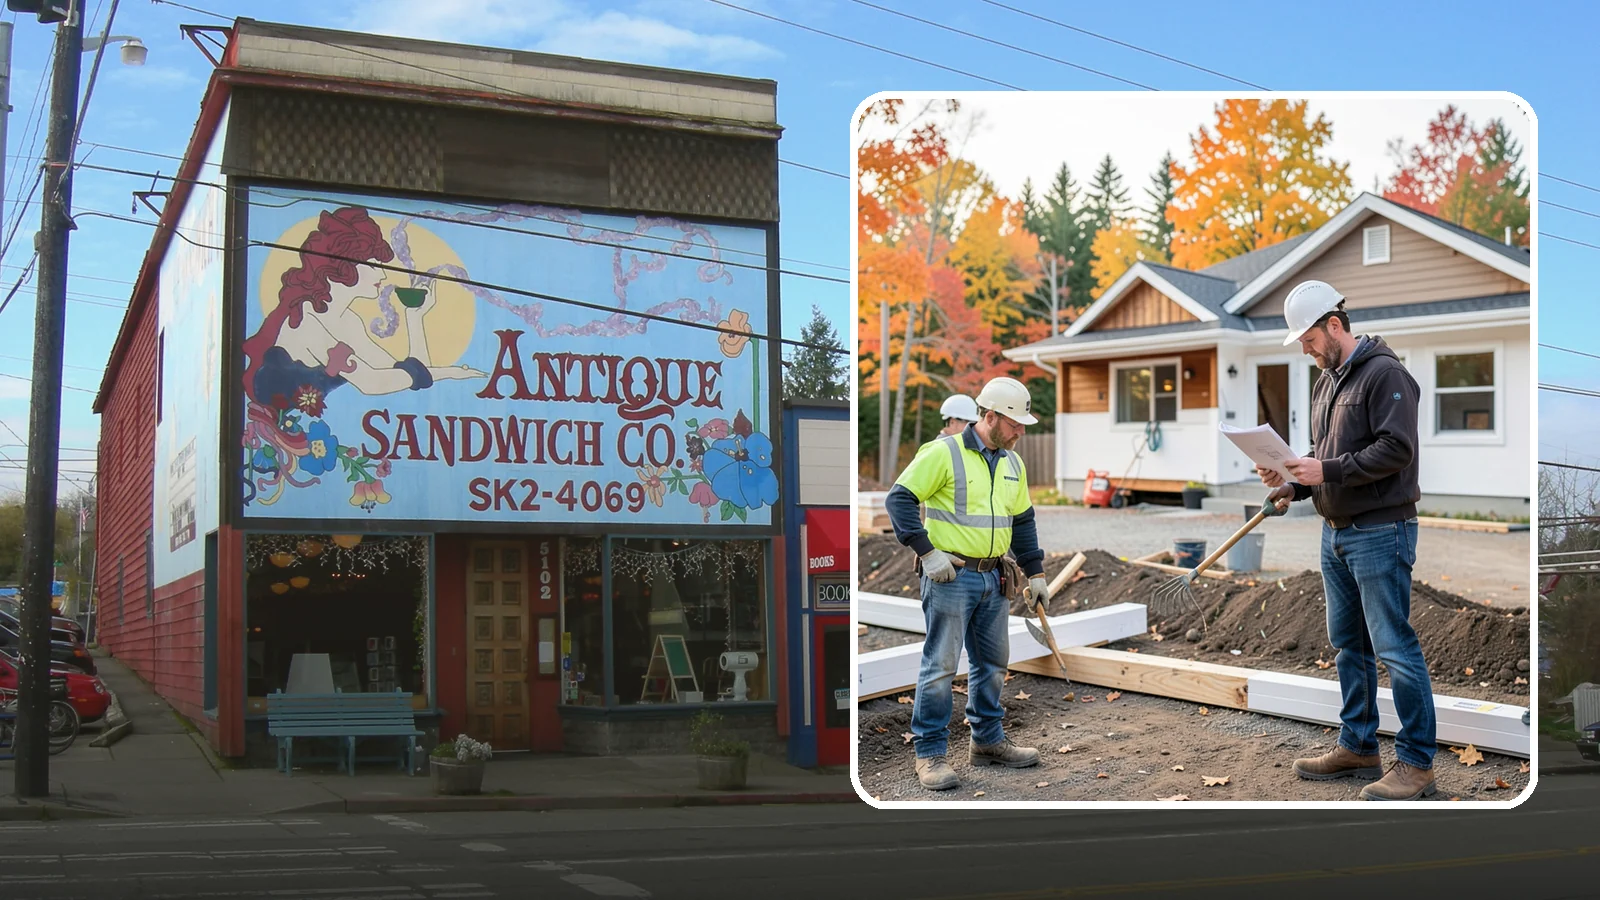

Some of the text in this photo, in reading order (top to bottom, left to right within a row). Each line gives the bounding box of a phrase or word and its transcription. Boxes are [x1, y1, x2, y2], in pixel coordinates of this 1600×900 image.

[476, 329, 723, 421] ANTIQUE
[361, 408, 685, 470] SANDWICH CO.
[468, 477, 646, 513] SK2-4069
[539, 541, 552, 600] 5102
[809, 555, 835, 569] BOOKS
